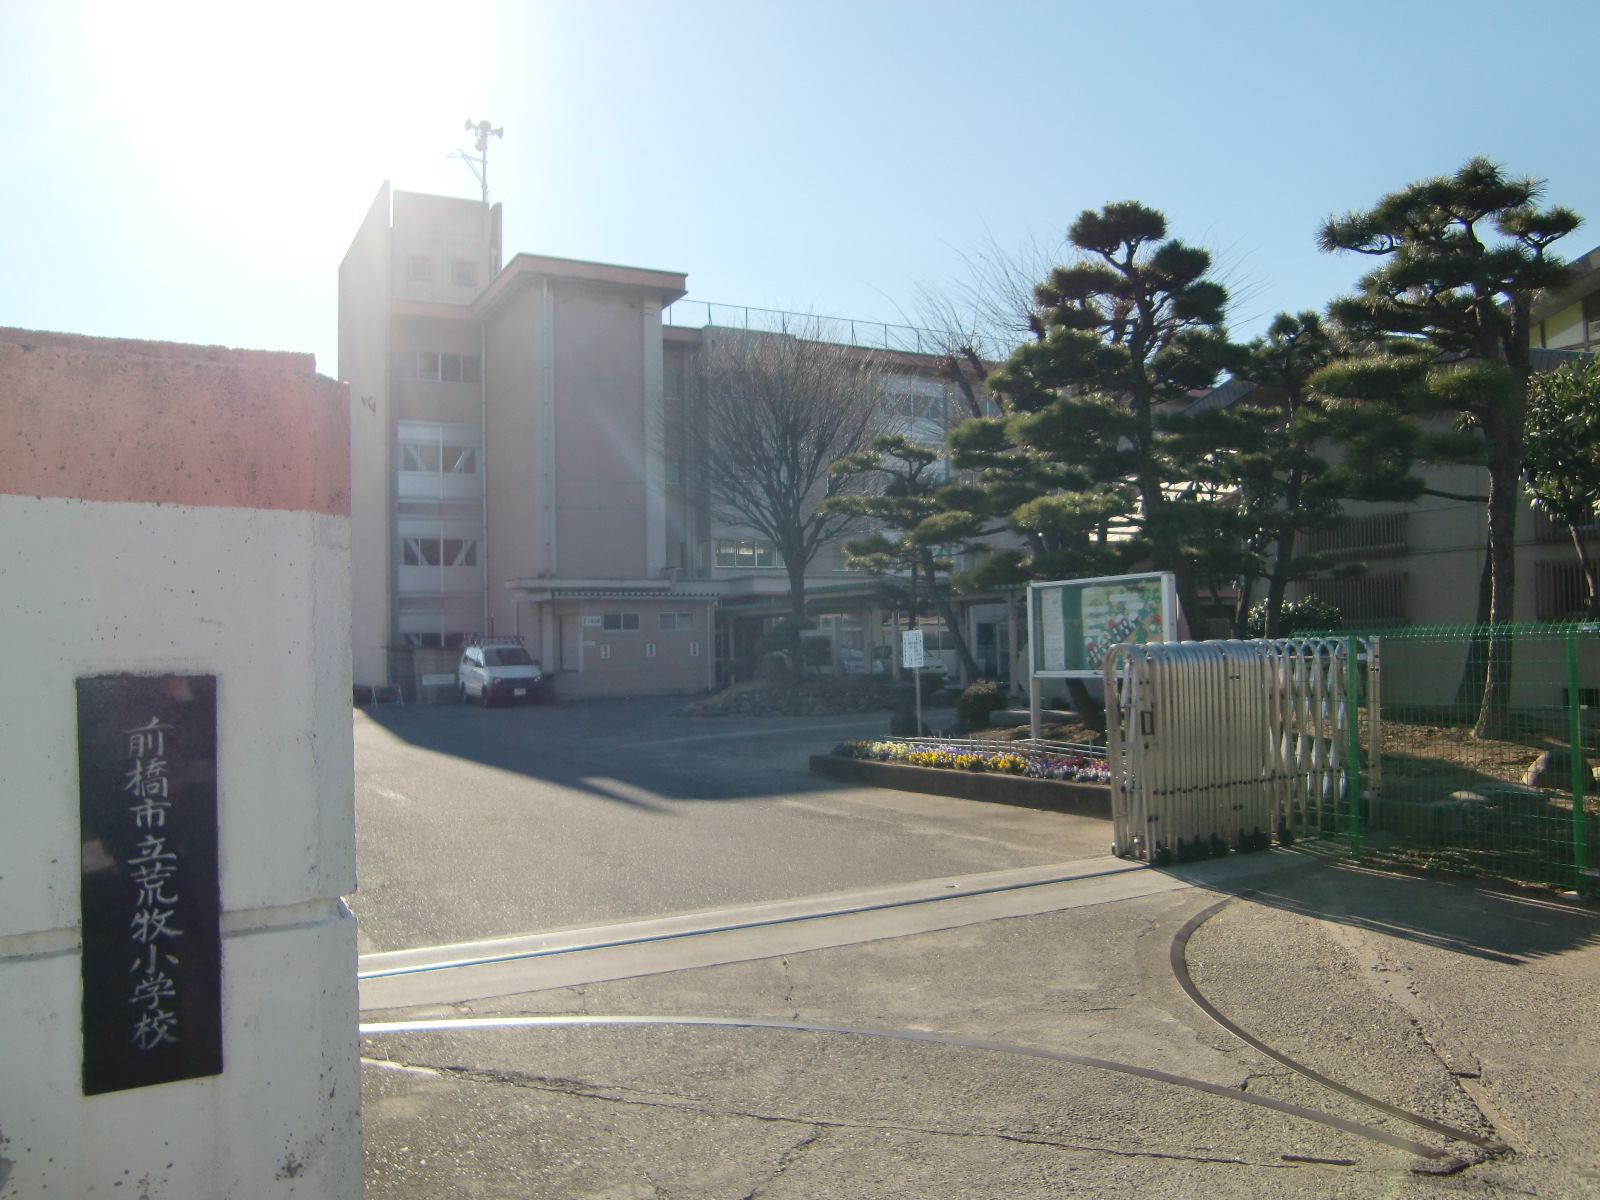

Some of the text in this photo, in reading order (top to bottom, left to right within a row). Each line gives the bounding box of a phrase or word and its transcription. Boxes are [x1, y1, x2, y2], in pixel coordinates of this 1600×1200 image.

[124, 715, 184, 1051] 前橋市立荒牧小学校
